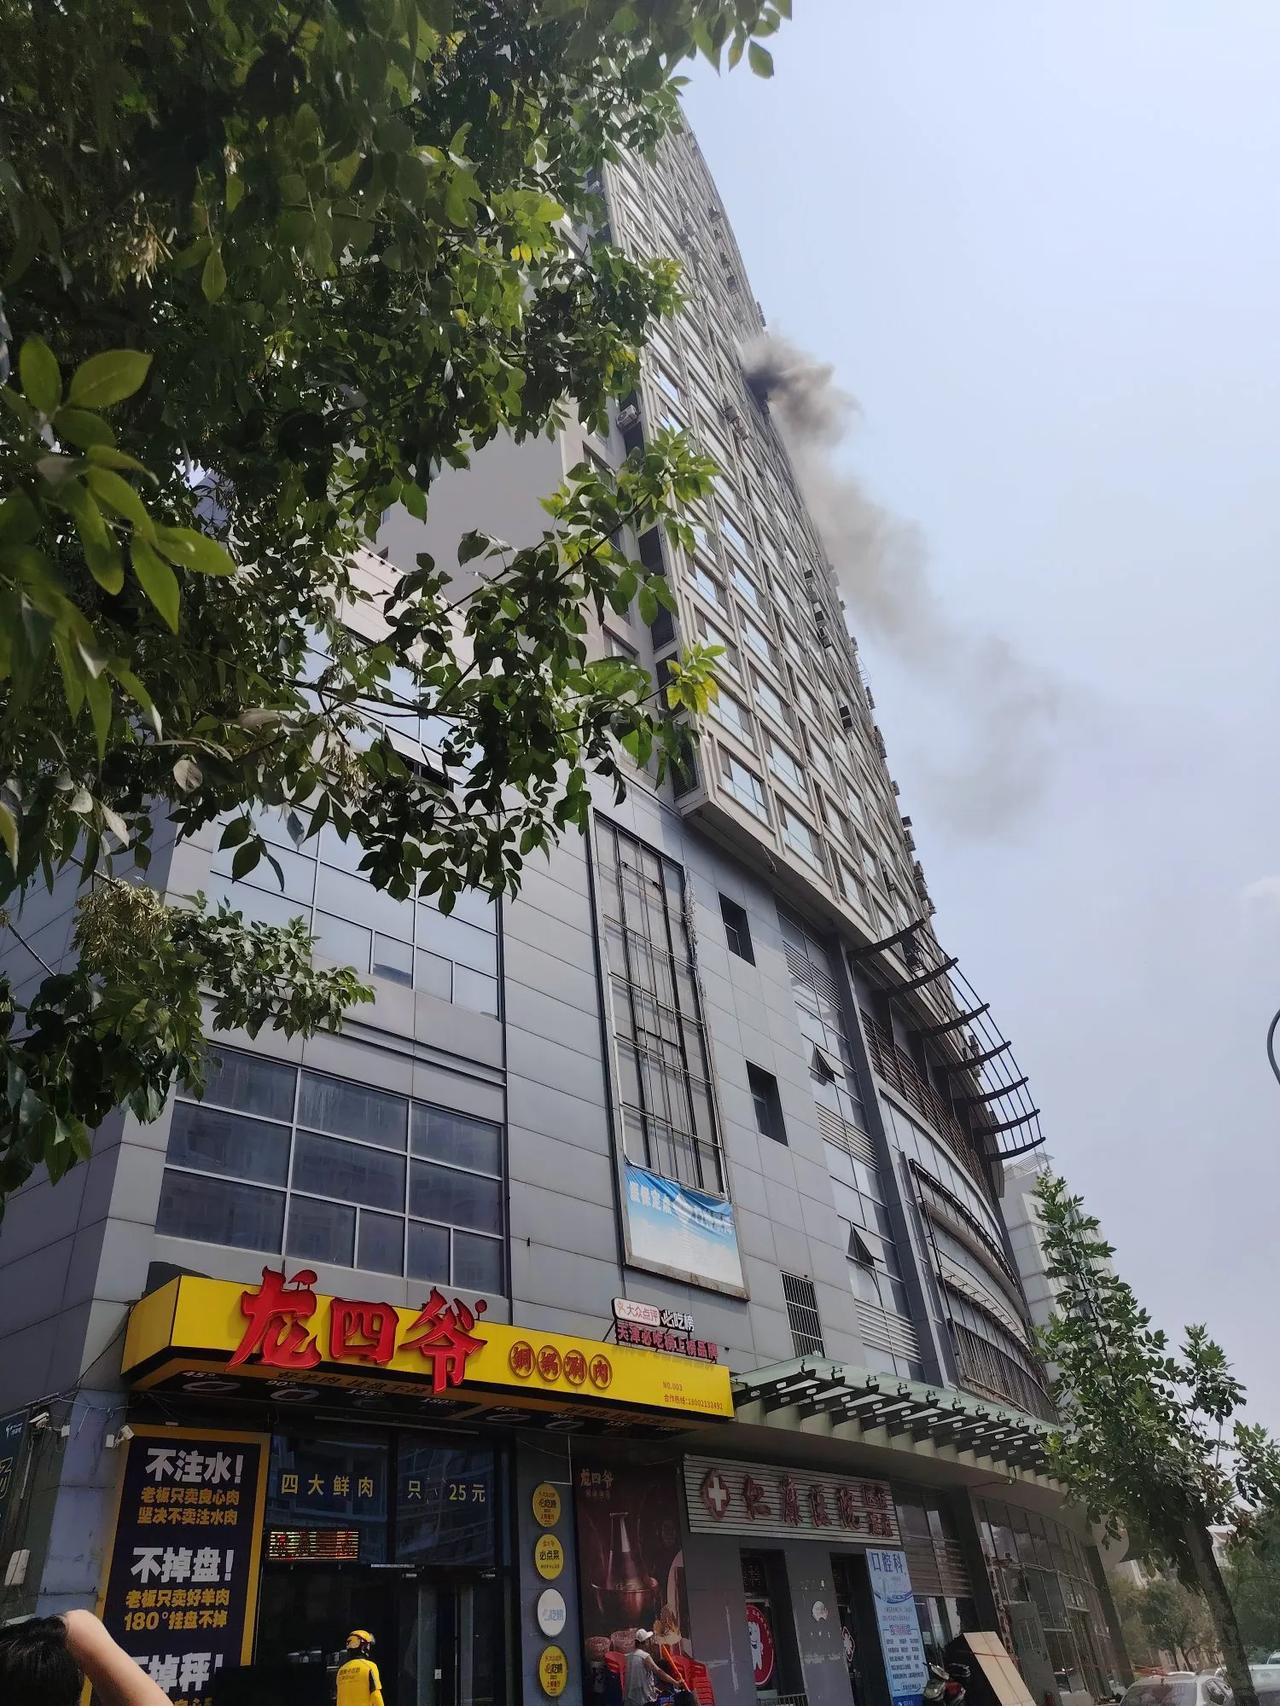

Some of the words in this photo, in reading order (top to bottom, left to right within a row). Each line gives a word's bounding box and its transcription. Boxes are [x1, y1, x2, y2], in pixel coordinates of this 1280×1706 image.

[627, 1304, 658, 1322] 大众点评
[661, 1310, 695, 1332] 必吃榜
[225, 1266, 488, 1395] 龙四爷
[145, 1448, 244, 1484] 不注水!
[141, 1486, 240, 1506] 老板只卖良心肉
[281, 1474, 374, 1498] 四大鲜肉
[137, 1507, 238, 1525] 坚决不卖注水肉
[131, 1547, 235, 1584] 不掉盘!
[871, 1552, 903, 1574] 口腔科
[126, 1588, 230, 1609] 老板只卖好羊肉
